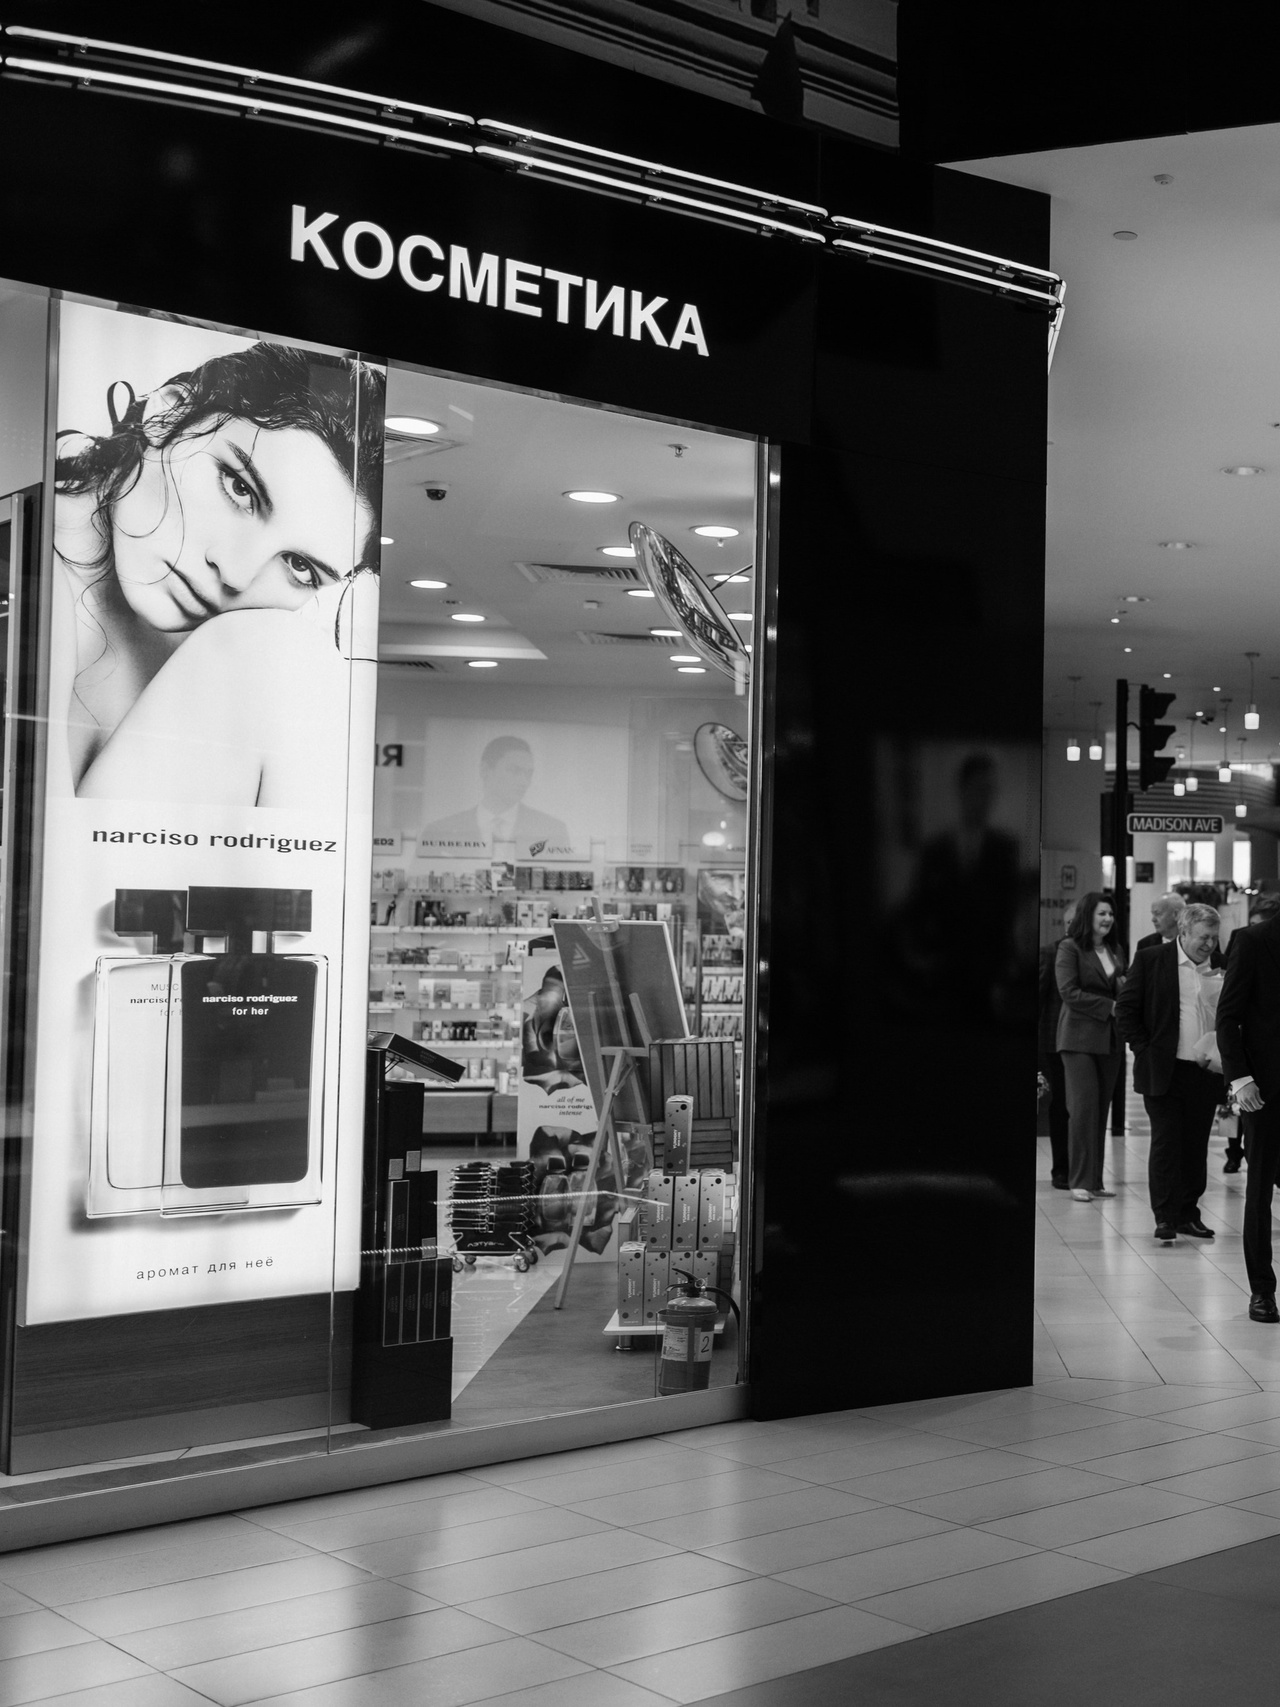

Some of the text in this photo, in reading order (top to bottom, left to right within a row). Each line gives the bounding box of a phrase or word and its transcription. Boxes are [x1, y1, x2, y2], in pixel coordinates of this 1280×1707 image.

[291, 204, 709, 357] КОСМЕТИКА
[1133, 817, 1218, 831] MADISON AVE
[92, 829, 337, 853] narciso rodriguez
[422, 840, 488, 848] BURBERRY
[202, 995, 298, 1004] narciso rodriguez
[232, 1007, 269, 1016] for her
[136, 1256, 273, 1281] аромат для неё
[701, 1336, 709, 1353] 2
